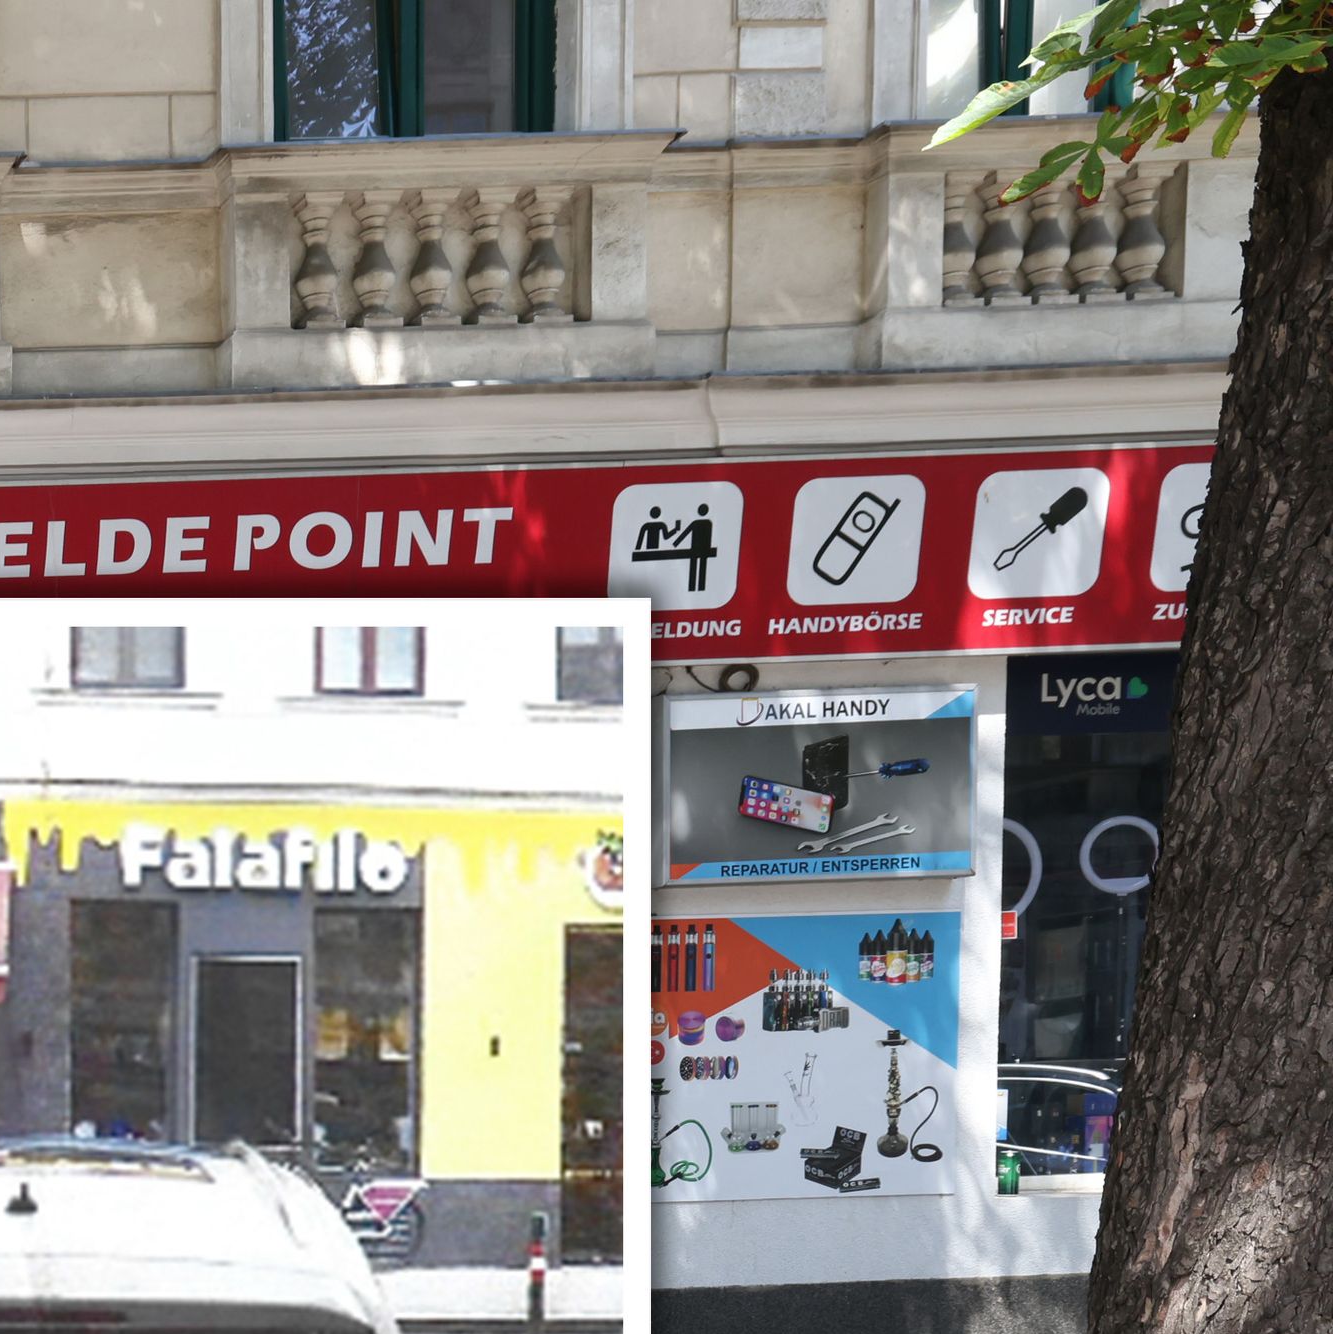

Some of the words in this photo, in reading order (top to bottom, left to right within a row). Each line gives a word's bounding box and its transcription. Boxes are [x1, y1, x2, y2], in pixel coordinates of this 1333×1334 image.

[235, 506, 513, 571] POINT
[981, 606, 1075, 628] SERVICE
[1152, 602, 1189, 621] ZU
[767, 609, 924, 637] HANDYBÖRSE
[1040, 672, 1122, 706] Lyca
[822, 698, 891, 719] HANDY
[1076, 702, 1121, 716] Mobile
[119, 825, 408, 894] Falafilo
[720, 859, 810, 877] REPARATUR
[821, 856, 921, 873] ENTSPERREN
[839, 1128, 861, 1141] OCB
